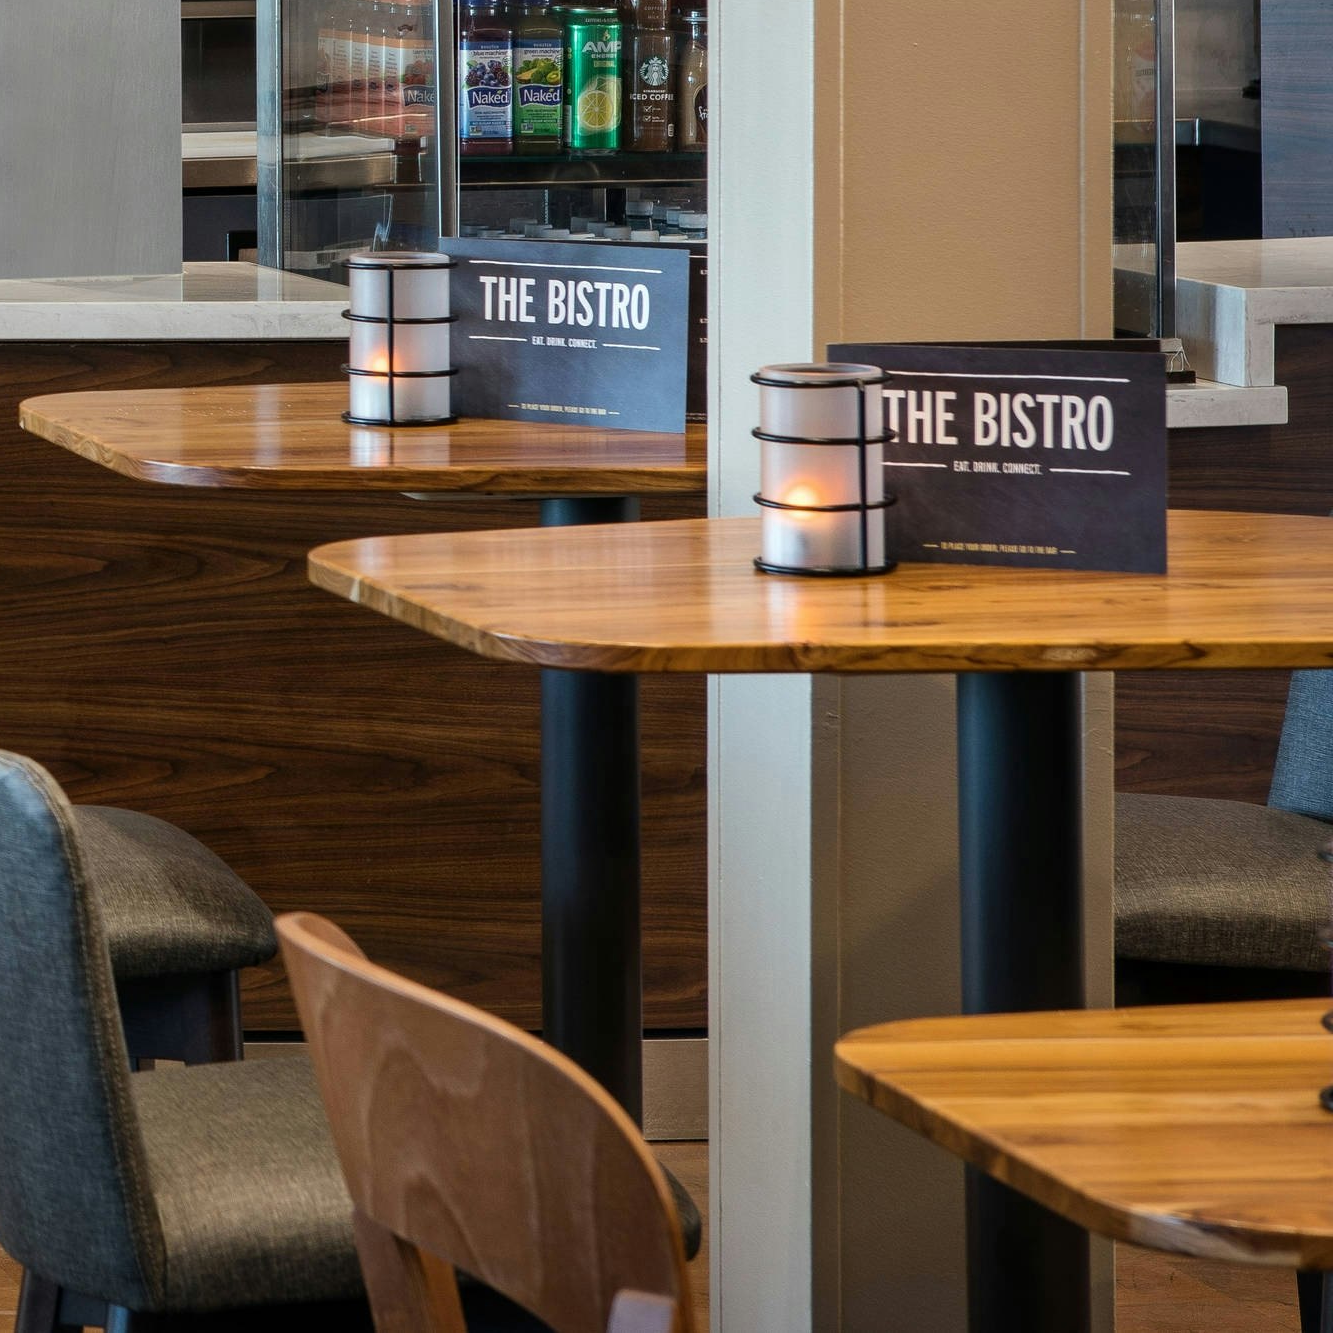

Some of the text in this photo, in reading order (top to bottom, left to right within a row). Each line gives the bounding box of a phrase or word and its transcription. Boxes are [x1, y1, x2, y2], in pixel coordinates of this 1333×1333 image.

[582, 41, 621, 53] AMP
[473, 90, 508, 104] Naked
[524, 88, 560, 102] Naked
[480, 276, 649, 330] THE BISTRO
[882, 390, 1113, 451] THE BISTRO
